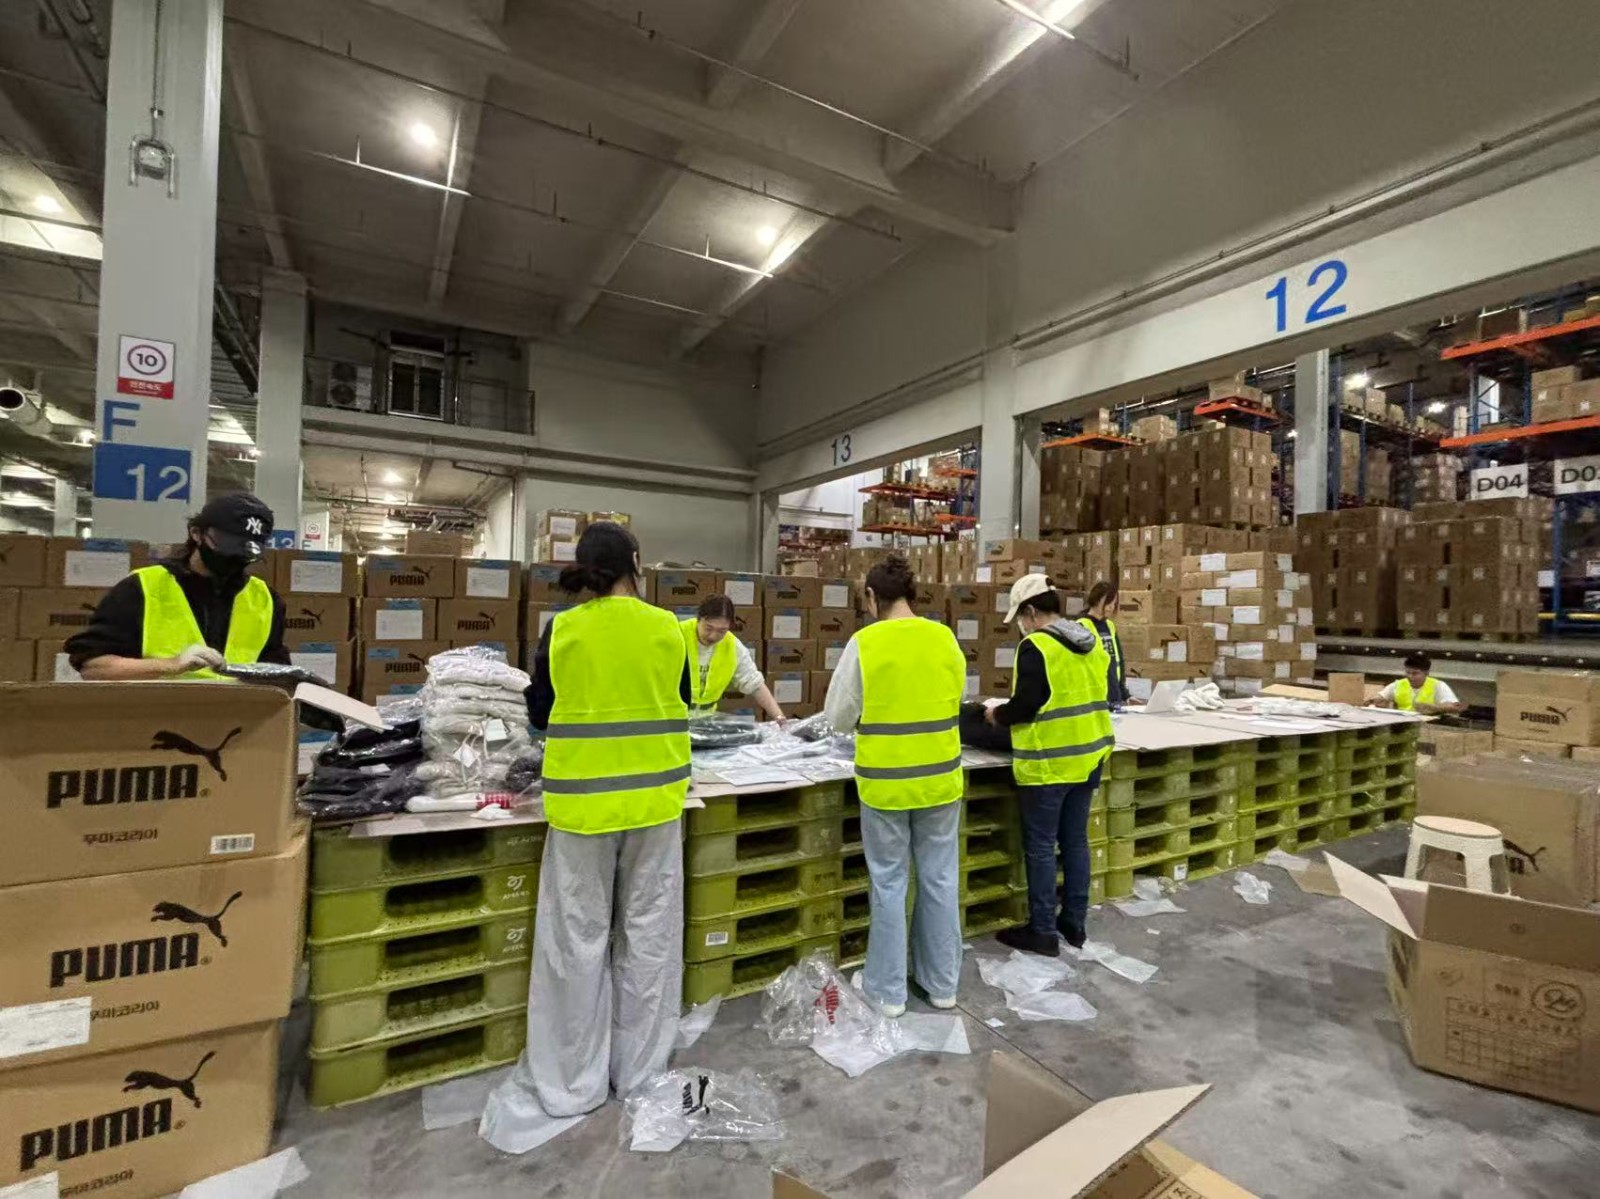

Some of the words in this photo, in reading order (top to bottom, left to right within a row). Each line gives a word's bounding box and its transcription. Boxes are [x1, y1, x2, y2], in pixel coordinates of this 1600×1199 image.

[1266, 260, 1348, 333] 12
[136, 353, 158, 367] 10
[103, 400, 140, 441] F
[831, 434, 851, 466] 13
[127, 463, 188, 501] 12
[1476, 474, 1524, 492] D04
[1520, 711, 1560, 725] PUMA
[47, 763, 198, 809] PUMA
[50, 932, 198, 988] PUMA
[20, 1098, 172, 1172] PUMA
